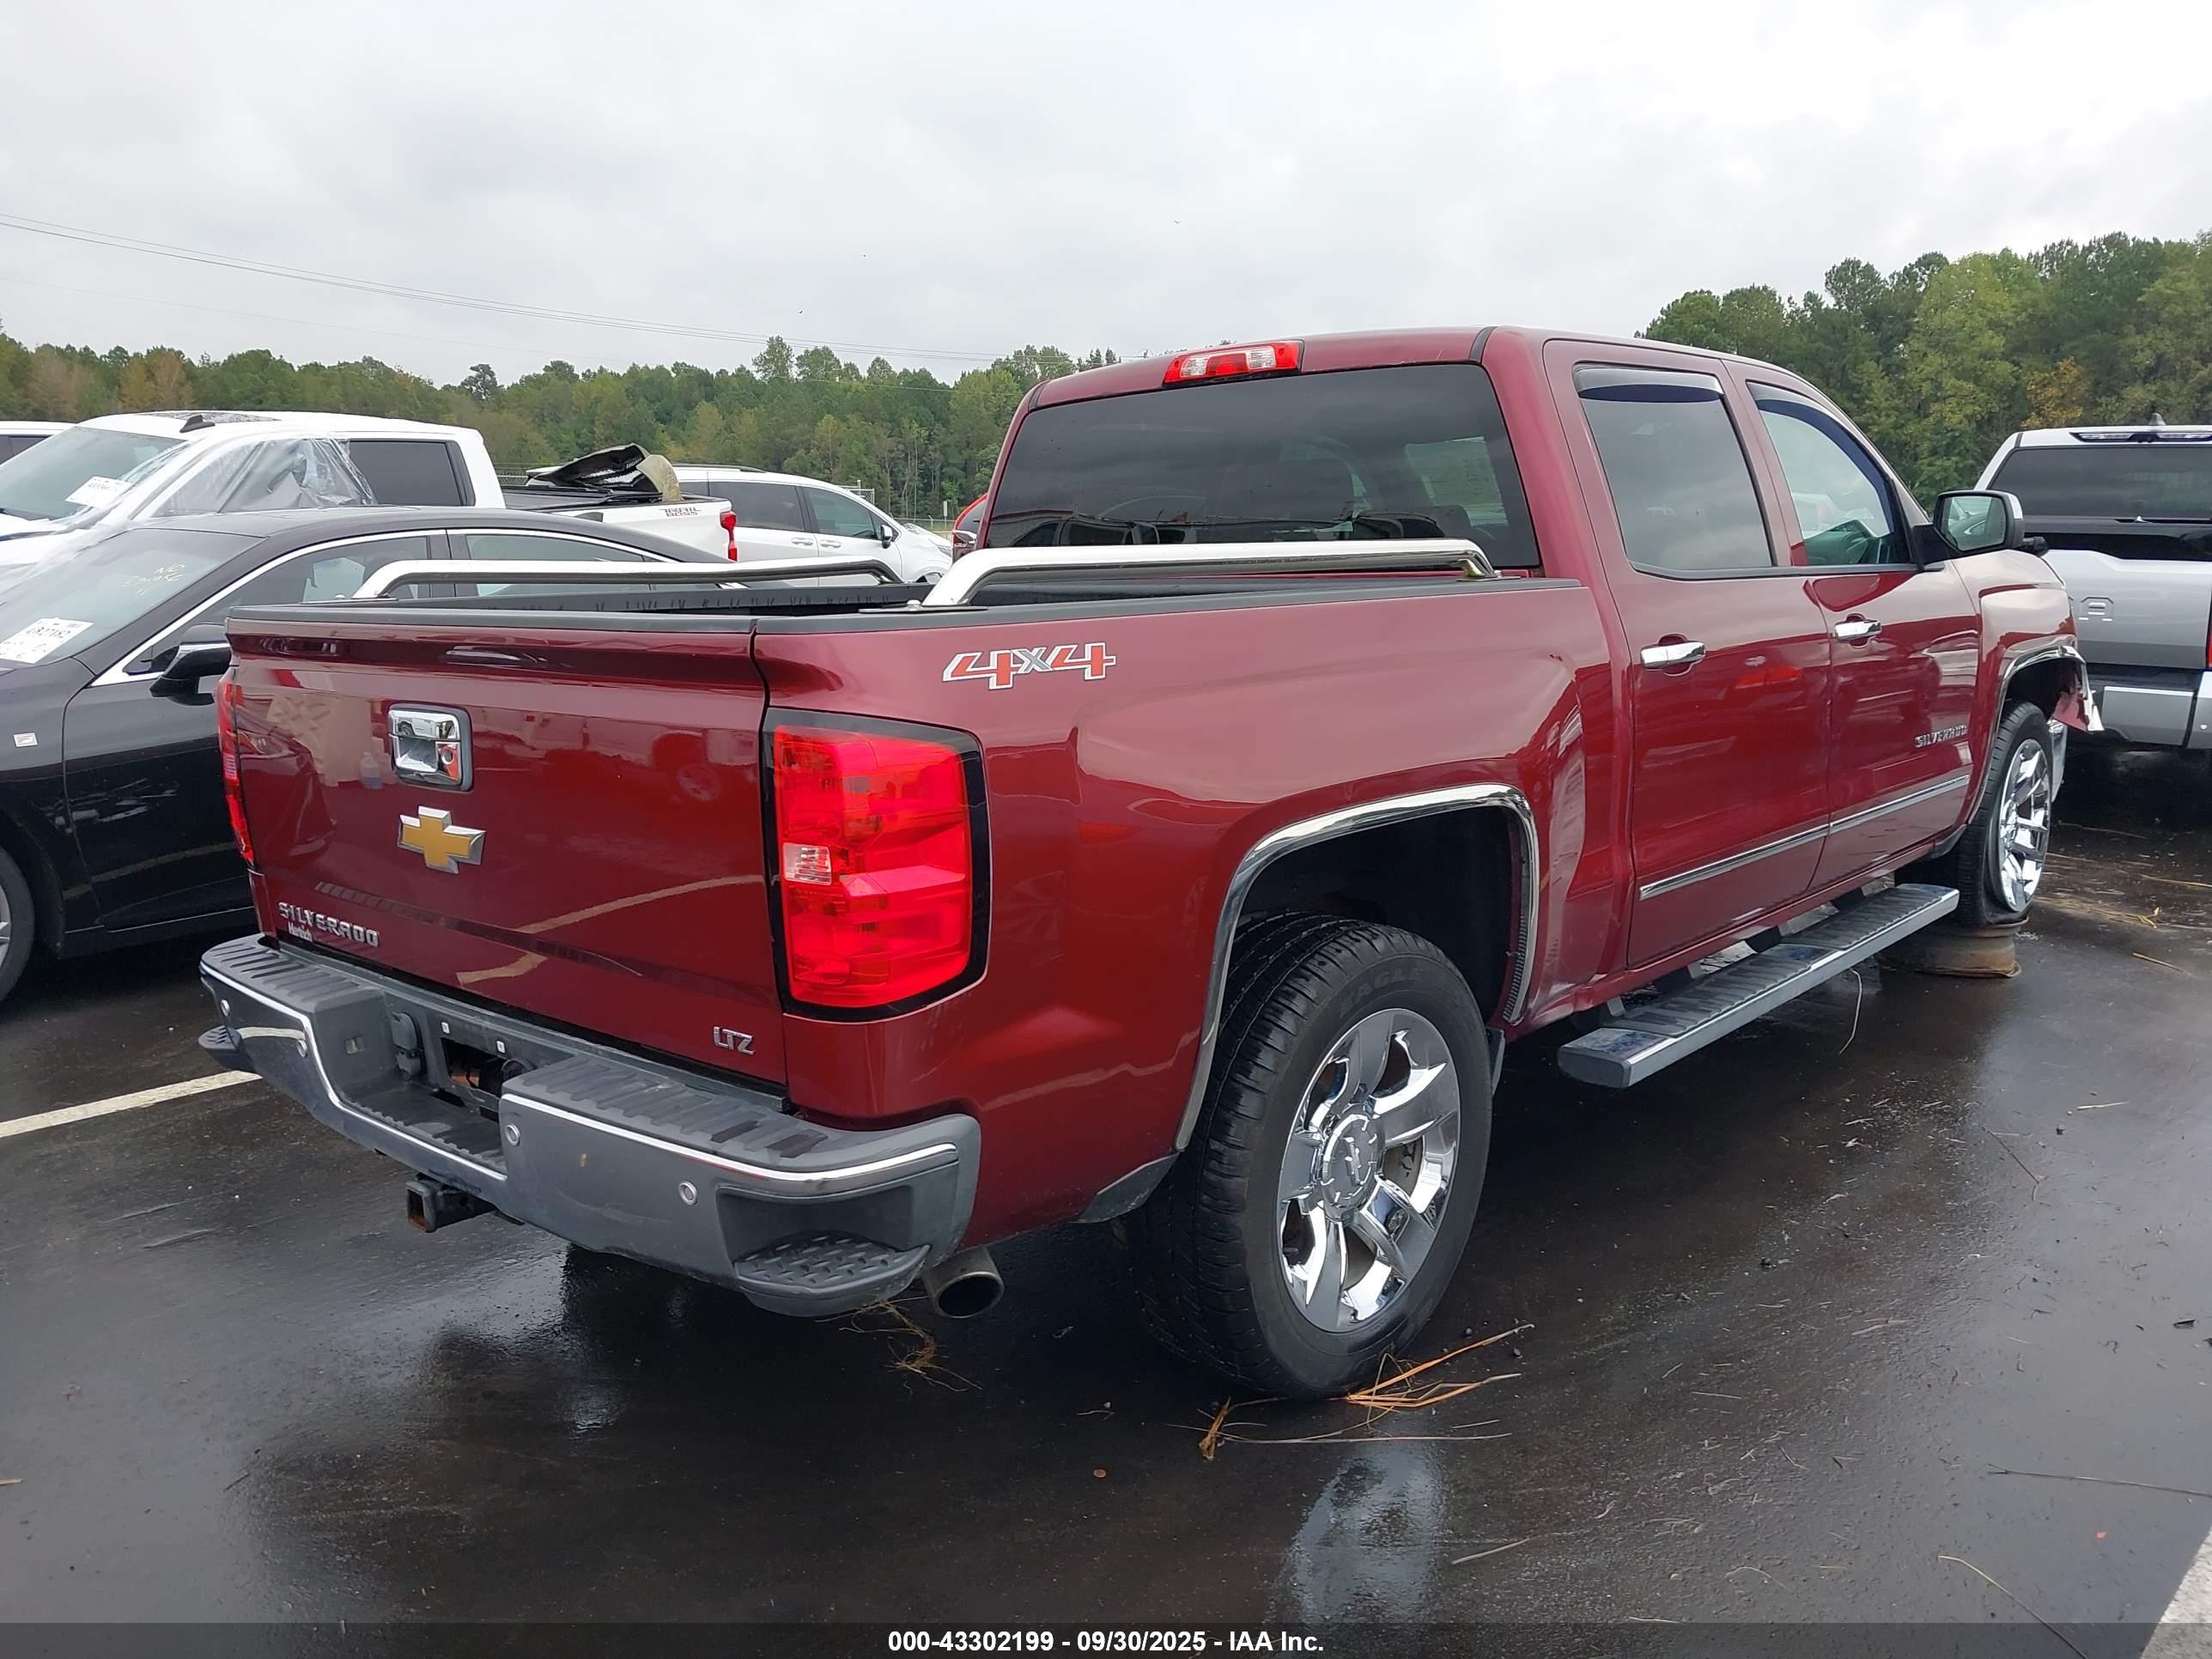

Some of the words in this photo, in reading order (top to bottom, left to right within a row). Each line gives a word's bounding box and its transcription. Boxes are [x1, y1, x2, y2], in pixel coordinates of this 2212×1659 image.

[1915, 724, 1966, 748] SILVERADO
[278, 902, 380, 948] SILVERADO
[1340, 966, 1425, 1018] EAGLE
[714, 1026, 754, 1055] LTZ
